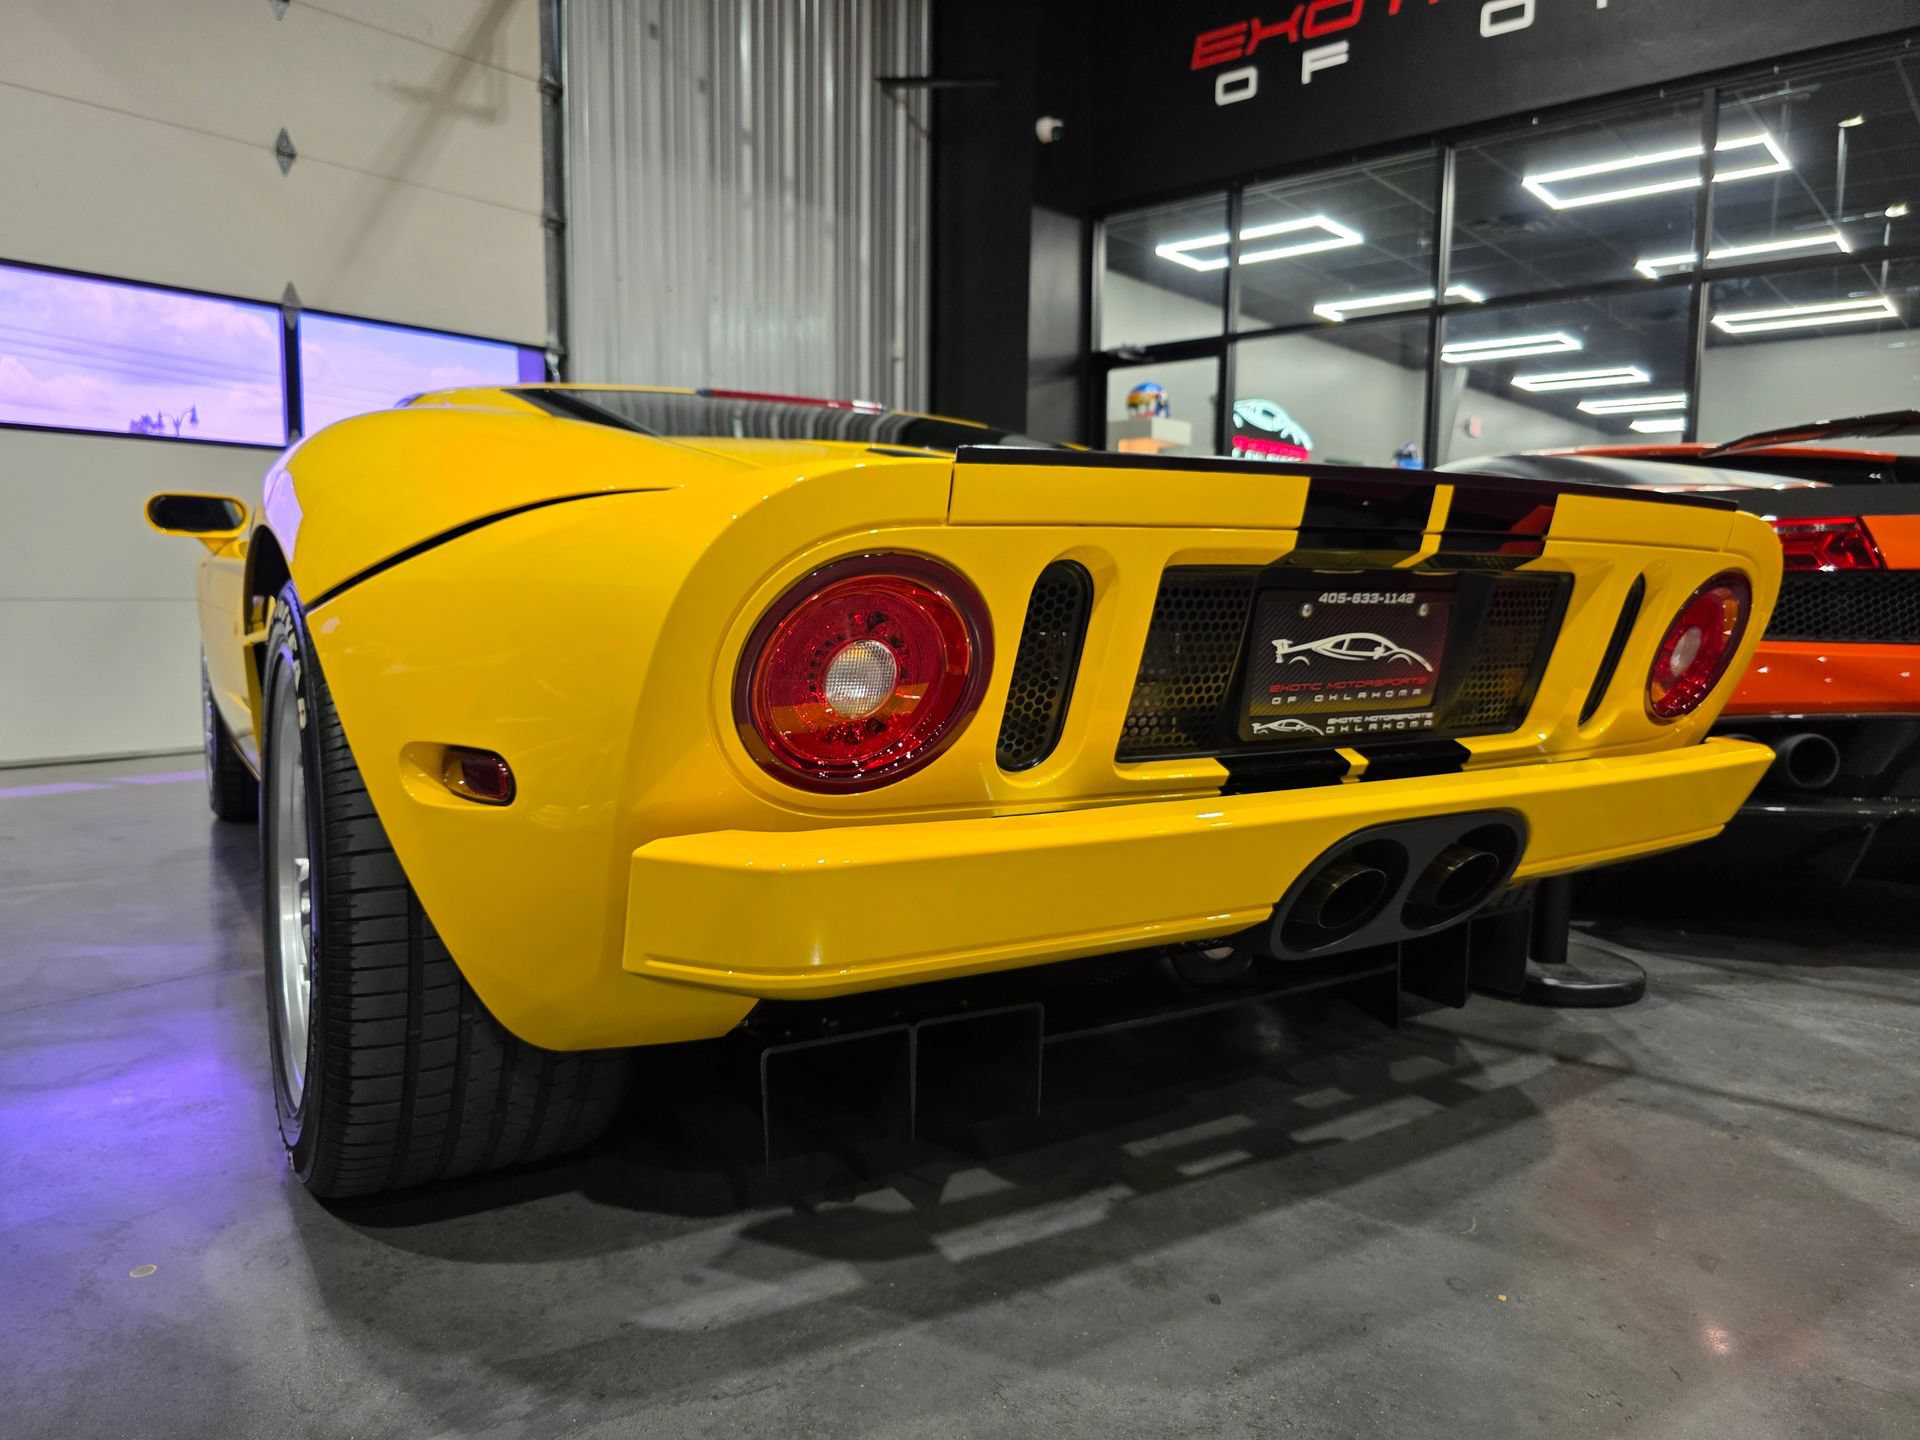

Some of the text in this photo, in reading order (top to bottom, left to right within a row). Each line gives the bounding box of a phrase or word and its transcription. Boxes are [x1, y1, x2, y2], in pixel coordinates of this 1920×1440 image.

[1215, 40, 1350, 106] OF
[1318, 592, 1416, 604] 405-633-1142
[1269, 676, 1428, 693] EXOTIC MOTORSPORTS
[1271, 688, 1422, 705] OF OKLAHOMA
[1325, 719, 1433, 734] OKLAHOMA
[1327, 712, 1434, 725] EXOTIC MOTORSPORTS
